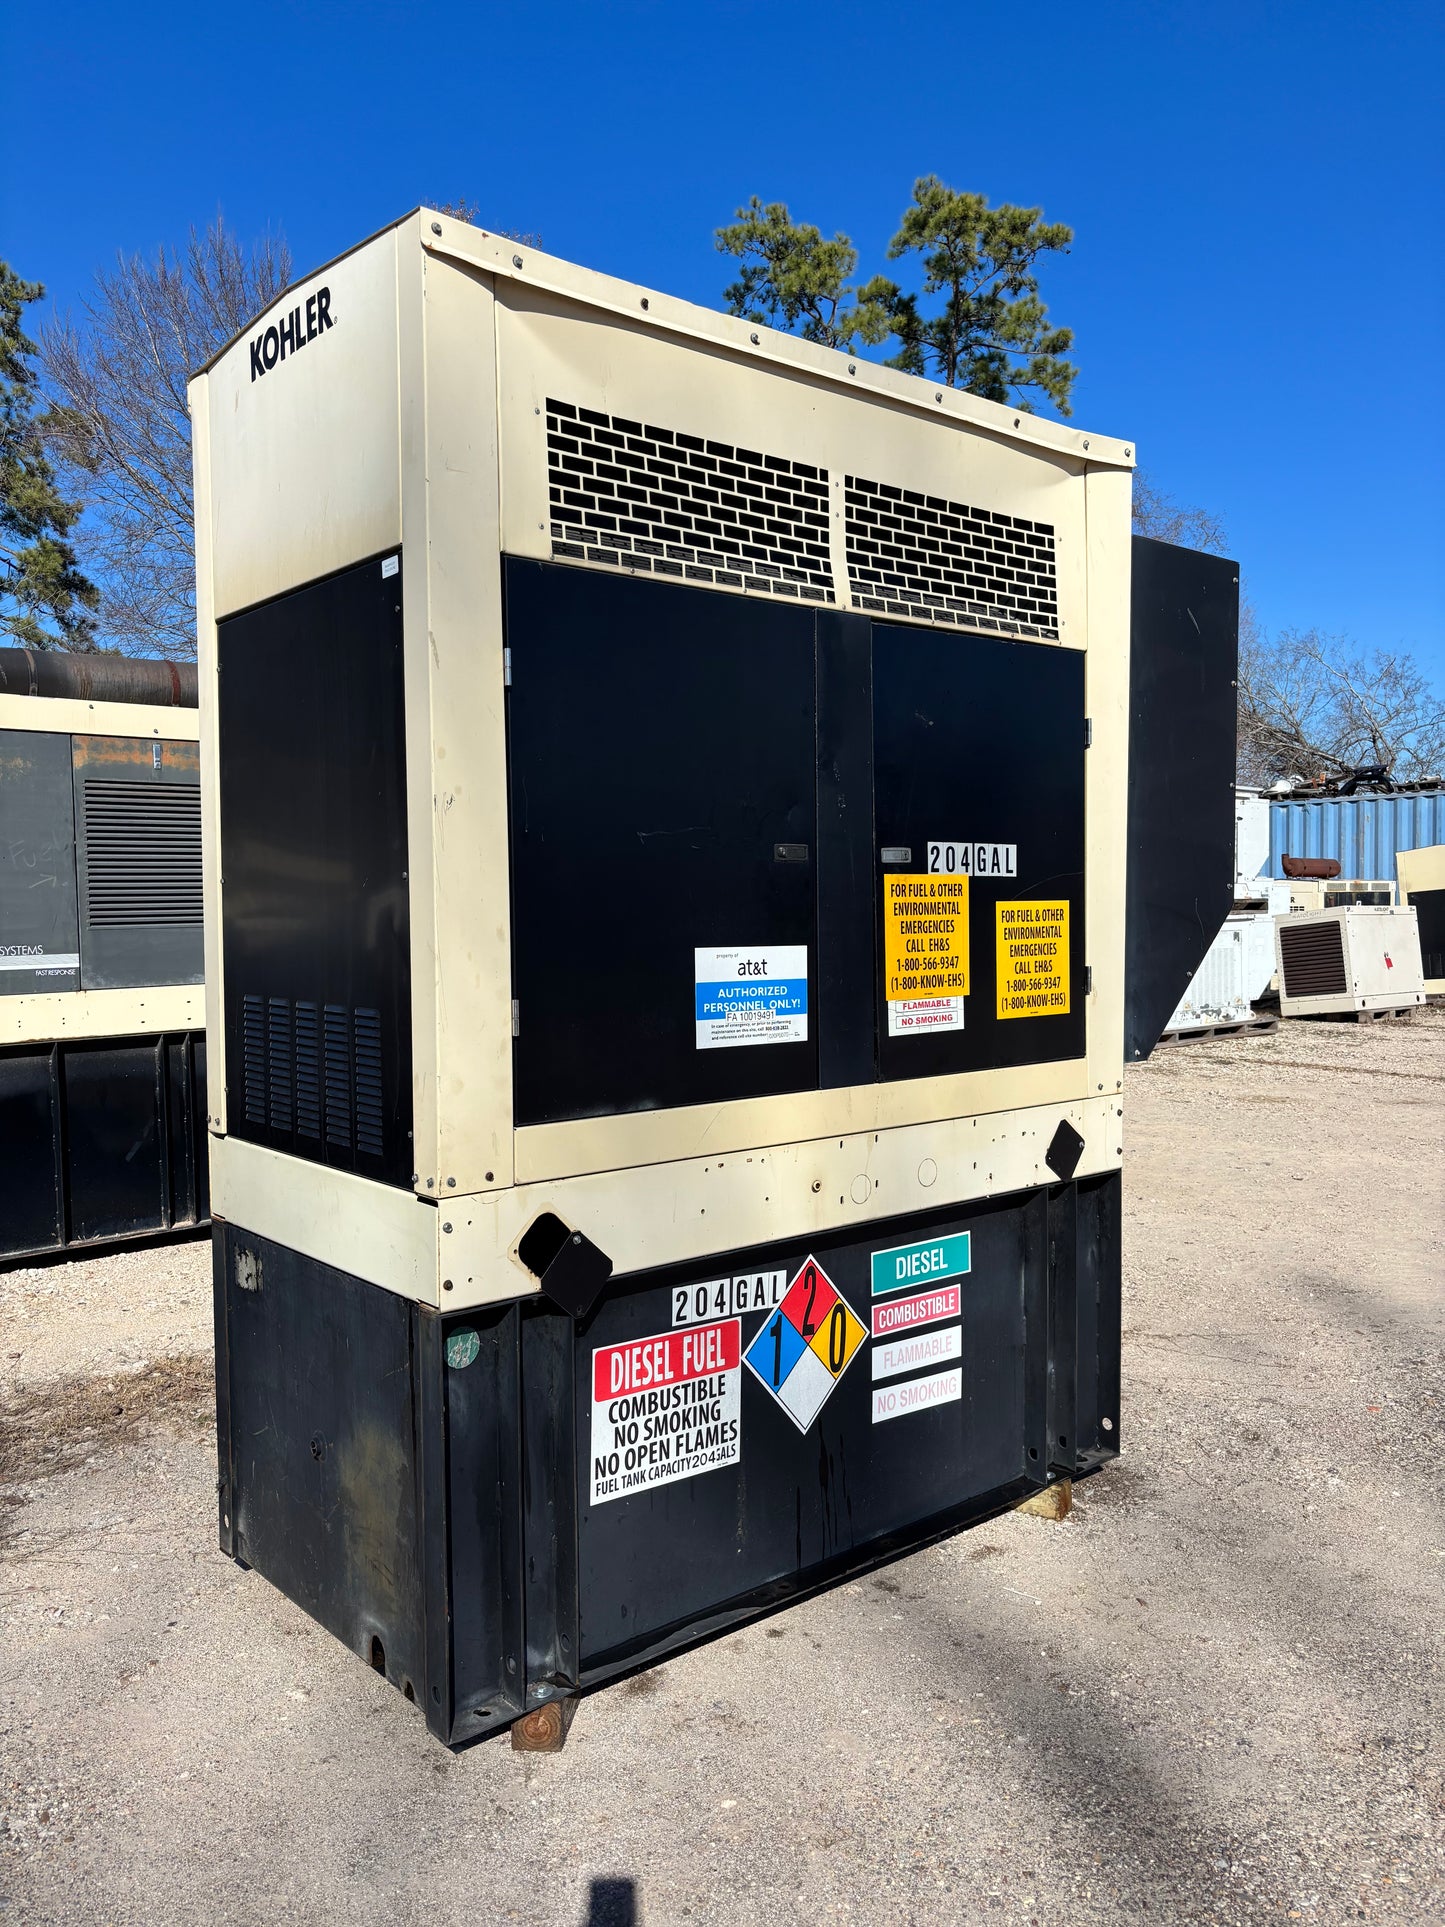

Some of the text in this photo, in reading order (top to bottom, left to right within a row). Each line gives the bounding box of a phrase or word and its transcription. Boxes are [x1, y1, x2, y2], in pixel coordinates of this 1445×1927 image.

[250, 287, 334, 383] KOHLER
[890, 883, 963, 898] FOR FUEL & OTHER
[893, 901, 961, 916] ENVIRONMENTAL
[1001, 908, 1065, 923] FOR FUEL & OTHER
[900, 919, 955, 935] EMERGENCIES
[1003, 925, 1062, 940] ENVIRONMENTAL
[0, 944, 44, 956] SYSTEMS
[906, 938, 950, 953] CALL EH&S
[1009, 942, 1057, 958] EMERGENCIES
[737, 958, 768, 976] at&t
[896, 955, 960, 972] 1-800-566-9347
[1014, 959, 1053, 975] CALL EH&S
[890, 973, 965, 993] (1-800-KNOW-EHS)
[1006, 976, 1061, 993] 1-800-566-9347
[717, 985, 788, 999] AUTHORIZED
[703, 998, 801, 1013] PERSONNEL ONLY!
[902, 999, 952, 1010] FLAMMABLE
[1001, 992, 1066, 1013] (1-800-KNOW-EHS)
[726, 1011, 775, 1022] FA 10019491
[901, 1014, 953, 1026] NO SMOKING
[896, 1247, 949, 1280] DIESEL
[802, 1265, 817, 1337] 2
[878, 1292, 955, 1329] COMBUSTIBLE
[829, 1302, 847, 1374] 0
[770, 1314, 783, 1387] 1
[883, 1335, 953, 1370] FLAMMABLE
[610, 1328, 726, 1394] DIESEL FUEL
[608, 1373, 726, 1424] COMBUSTIBLE
[877, 1376, 957, 1414] NO SMOKING
[614, 1399, 721, 1450] NO SMOKING
[594, 1418, 738, 1480] NO OPEN FLAMES
[596, 1478, 620, 1497] FUEL
[621, 1469, 646, 1489] TANK
[648, 1456, 692, 1481] CAPACITY
